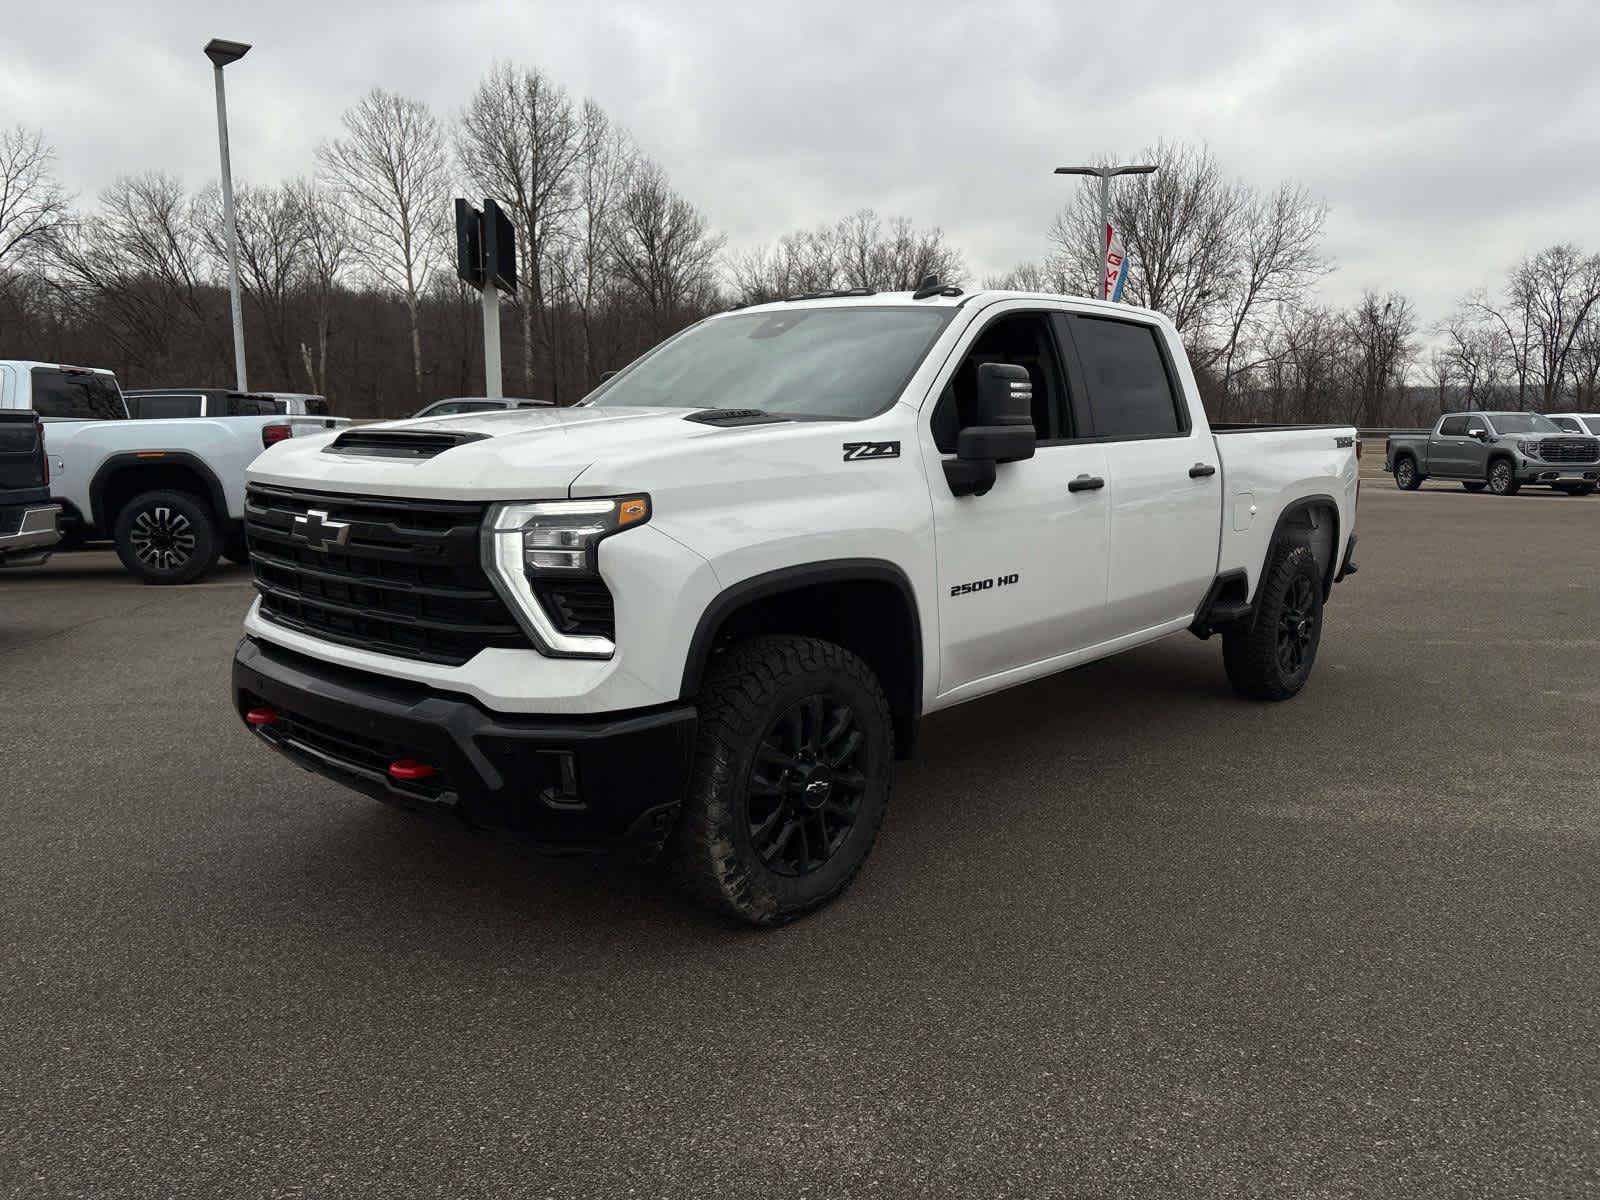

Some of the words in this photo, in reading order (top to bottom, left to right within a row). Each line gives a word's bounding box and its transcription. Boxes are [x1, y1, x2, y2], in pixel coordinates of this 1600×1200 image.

[843, 441, 901, 462] Z71
[951, 578, 994, 597] 2500
[997, 573, 1019, 587] HD
